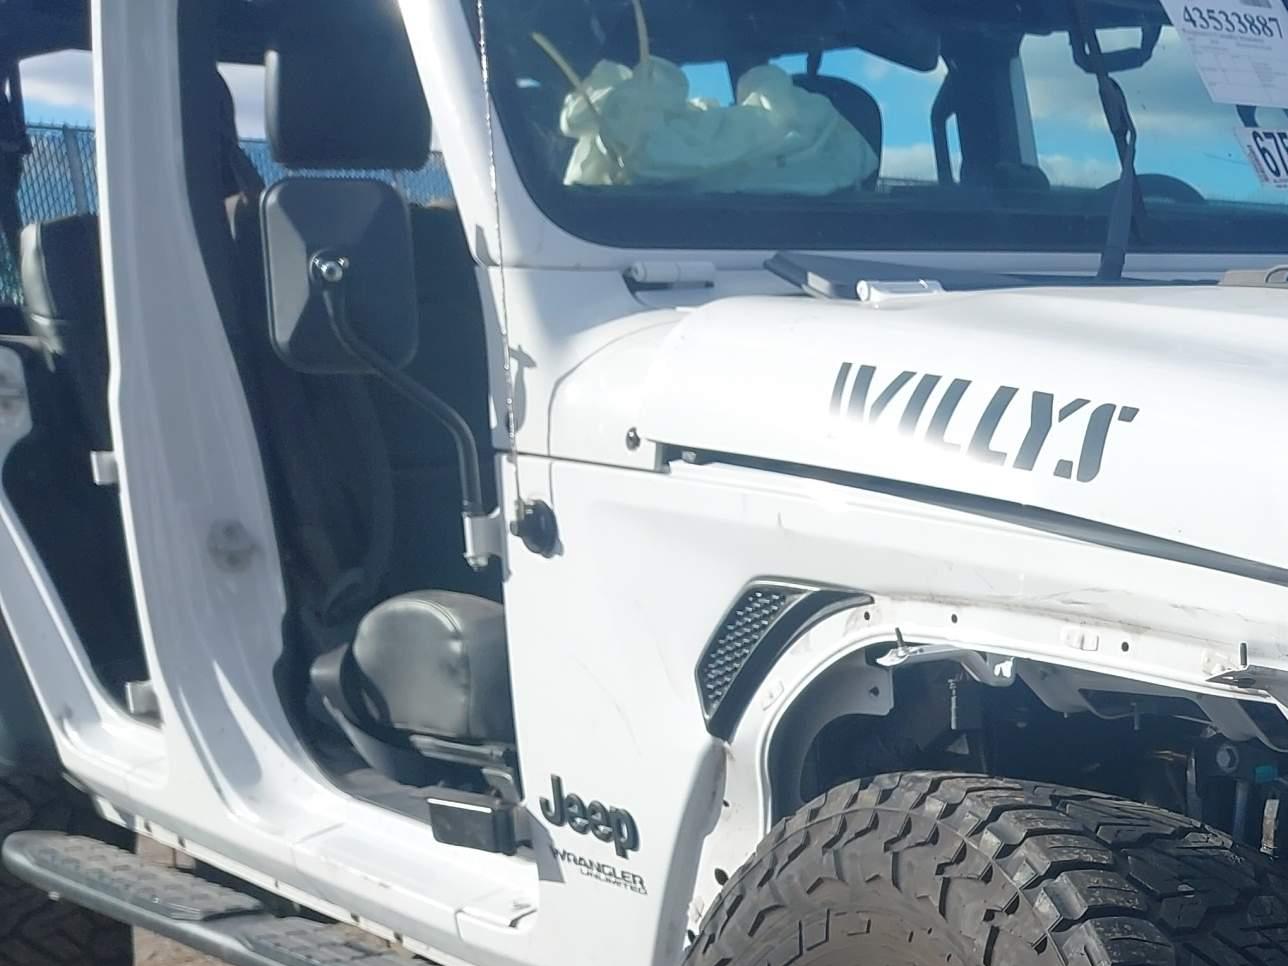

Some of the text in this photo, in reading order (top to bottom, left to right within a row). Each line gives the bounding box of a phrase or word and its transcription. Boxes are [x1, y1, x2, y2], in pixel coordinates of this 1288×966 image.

[1183, 5, 1283, 38] 43533887
[829, 361, 1140, 483] WILLYS
[539, 773, 640, 860] Jeep
[549, 845, 647, 890] WRANGLER
